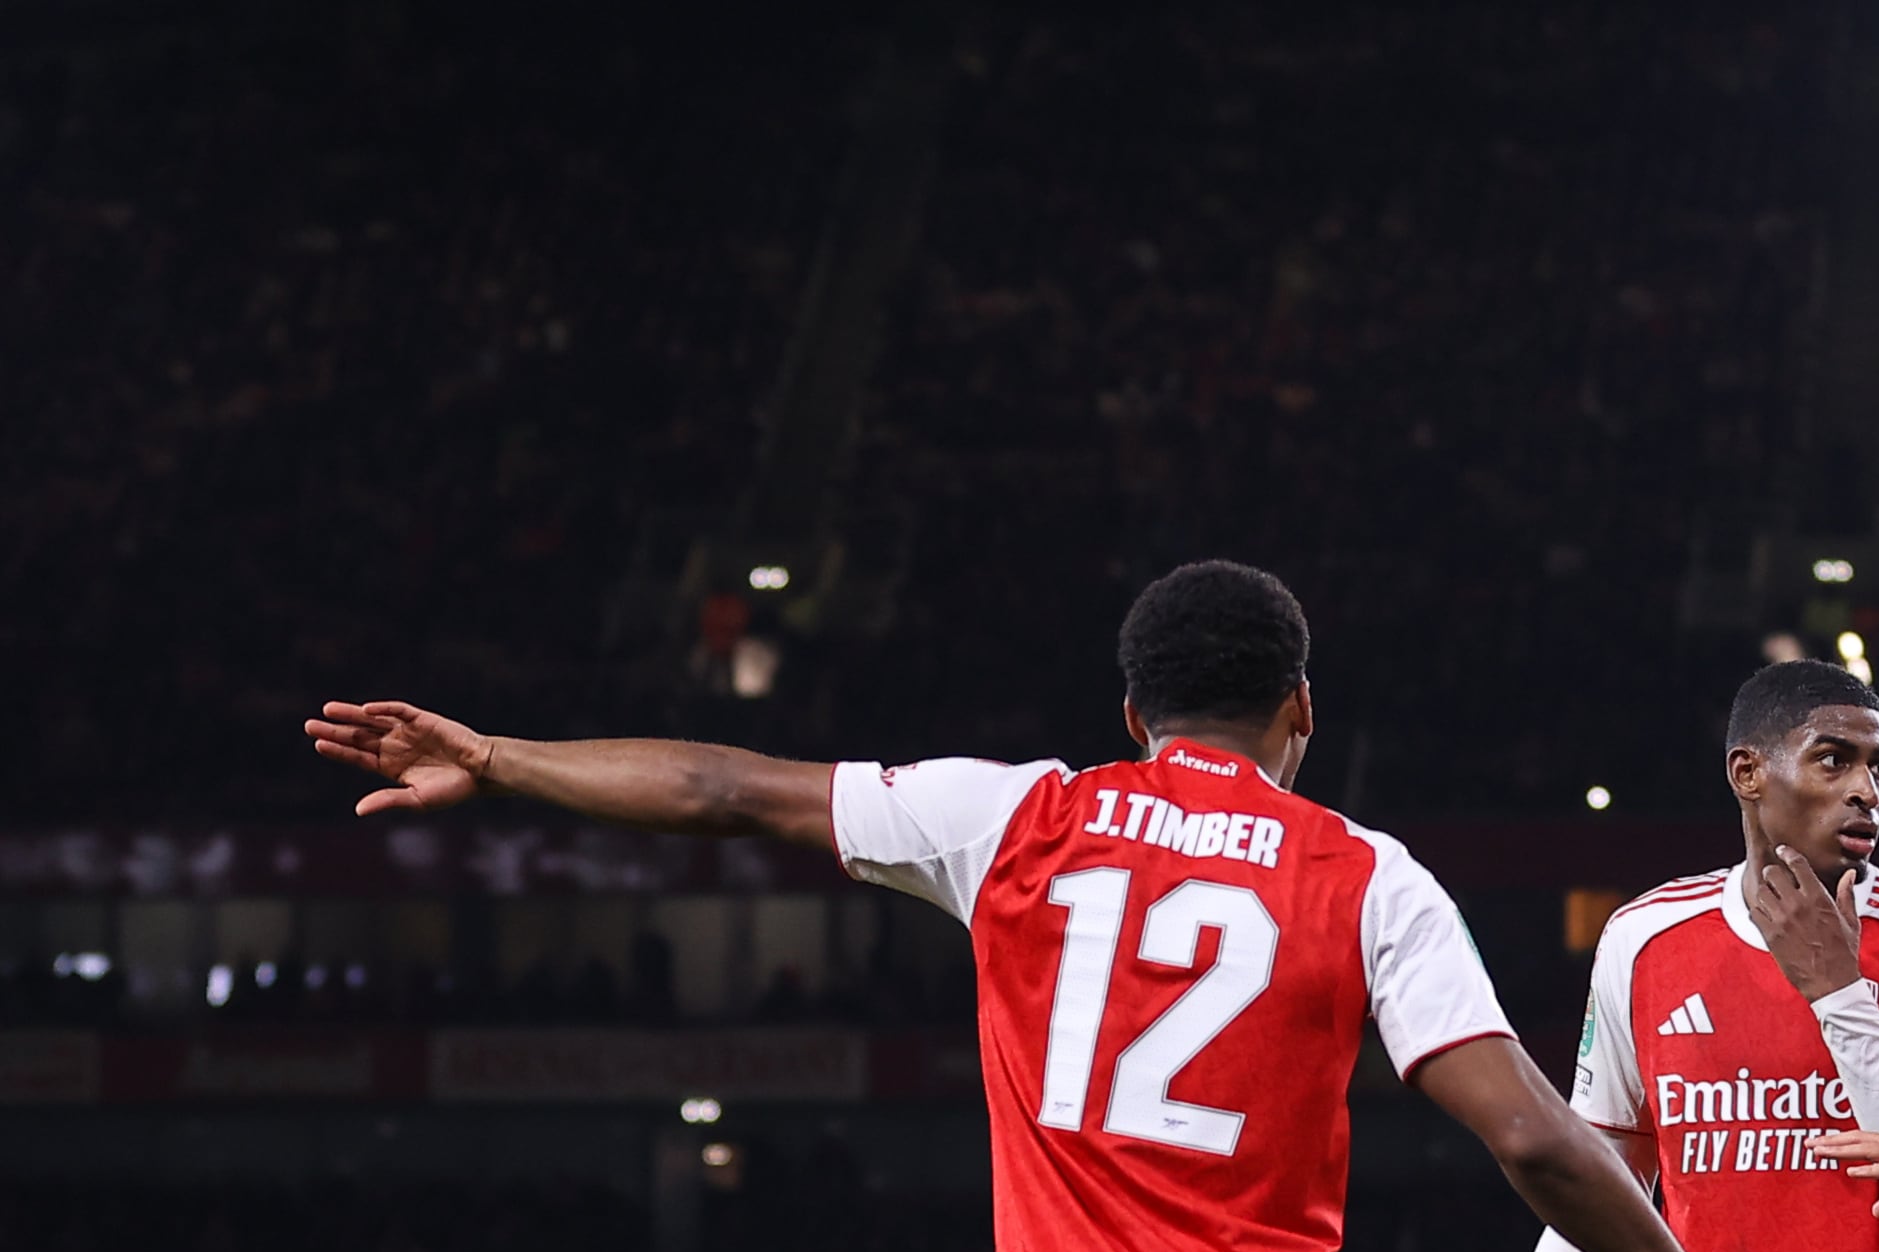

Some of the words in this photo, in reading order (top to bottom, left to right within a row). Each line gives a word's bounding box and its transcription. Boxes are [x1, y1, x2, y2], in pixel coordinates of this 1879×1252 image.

[1083, 789, 1285, 869] J.TIMBER
[1038, 866, 1280, 1156] 12
[1656, 1067, 1851, 1127] Emirate
[1682, 1131, 1730, 1174] FLY
